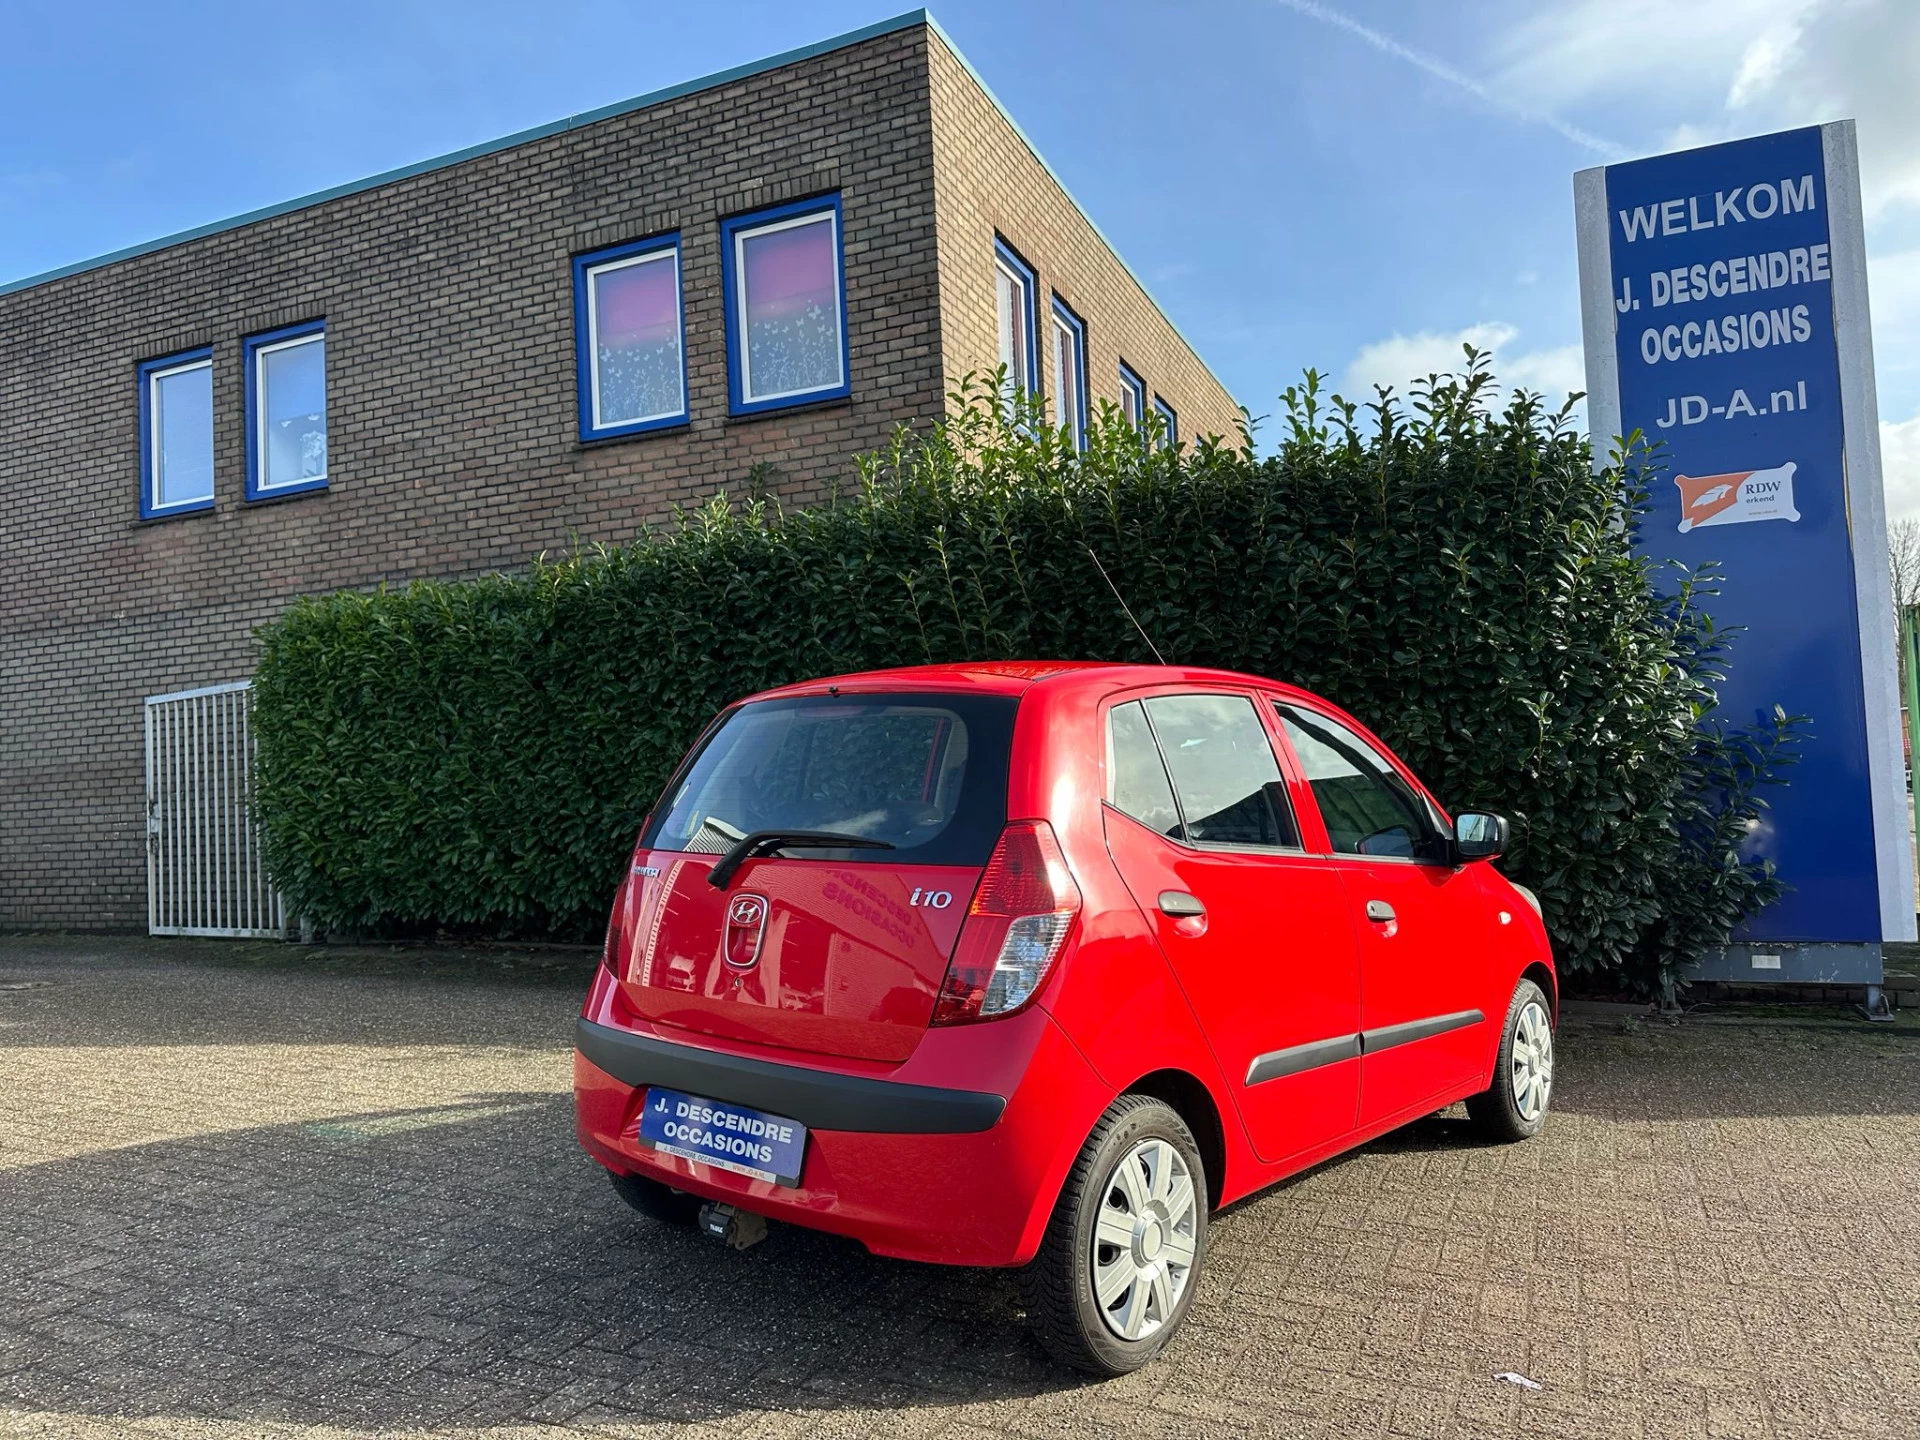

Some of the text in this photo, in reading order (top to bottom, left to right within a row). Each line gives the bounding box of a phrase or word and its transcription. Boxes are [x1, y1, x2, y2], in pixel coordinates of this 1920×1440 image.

[1619, 174, 1815, 243] WELKOM
[1616, 243, 1831, 313] J. DESCENDRE
[1641, 304, 1811, 365] OCCASIONS
[1656, 380, 1807, 428] JD-A.nl
[1745, 480, 1781, 495] RDW
[1745, 494, 1775, 504] erkend
[909, 887, 953, 909] i10
[654, 1097, 793, 1144] J. DESCENDRE
[663, 1121, 773, 1163] OCCASIONS
